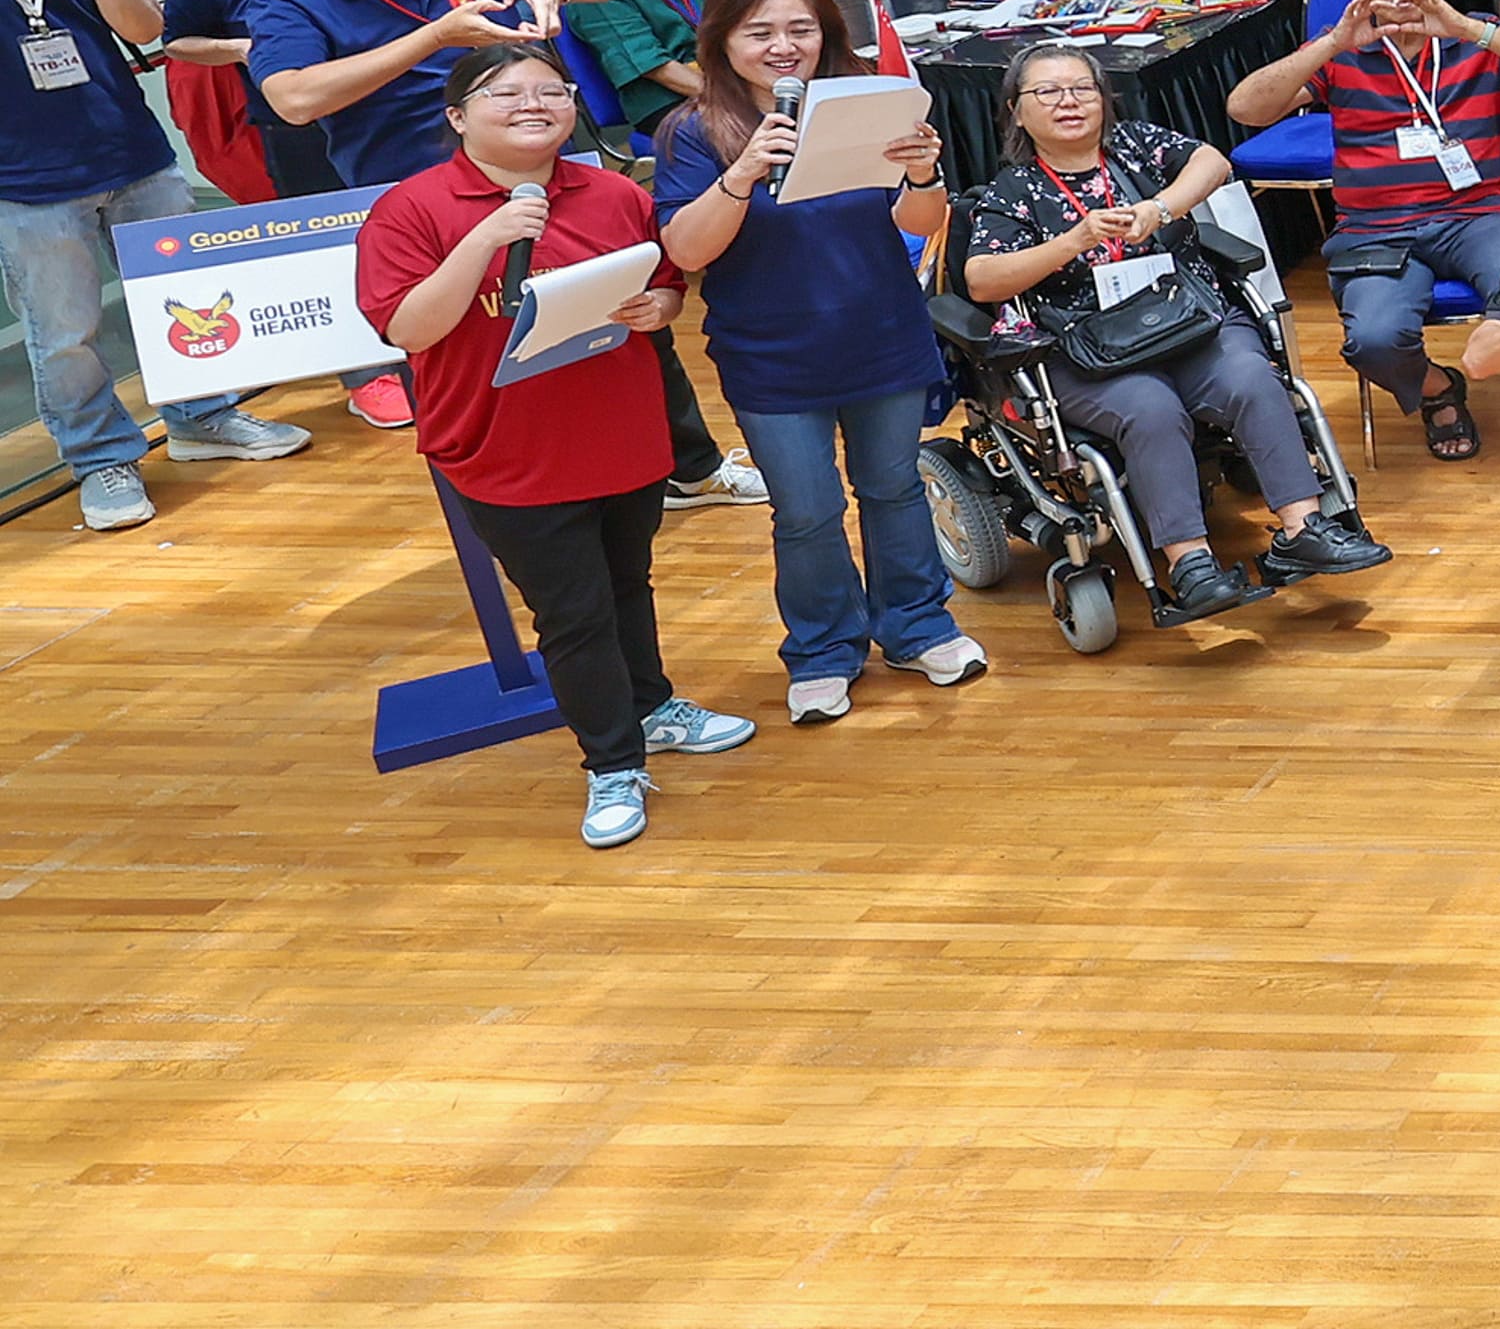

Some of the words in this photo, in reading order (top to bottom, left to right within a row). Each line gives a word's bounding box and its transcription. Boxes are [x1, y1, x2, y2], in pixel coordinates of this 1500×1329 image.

[38, 56, 79, 72] TB-14
[189, 225, 261, 249] Good
[266, 217, 302, 236] for
[249, 296, 333, 323] GOLDEN
[251, 311, 334, 338] HEARTS
[187, 338, 228, 356] RGE
